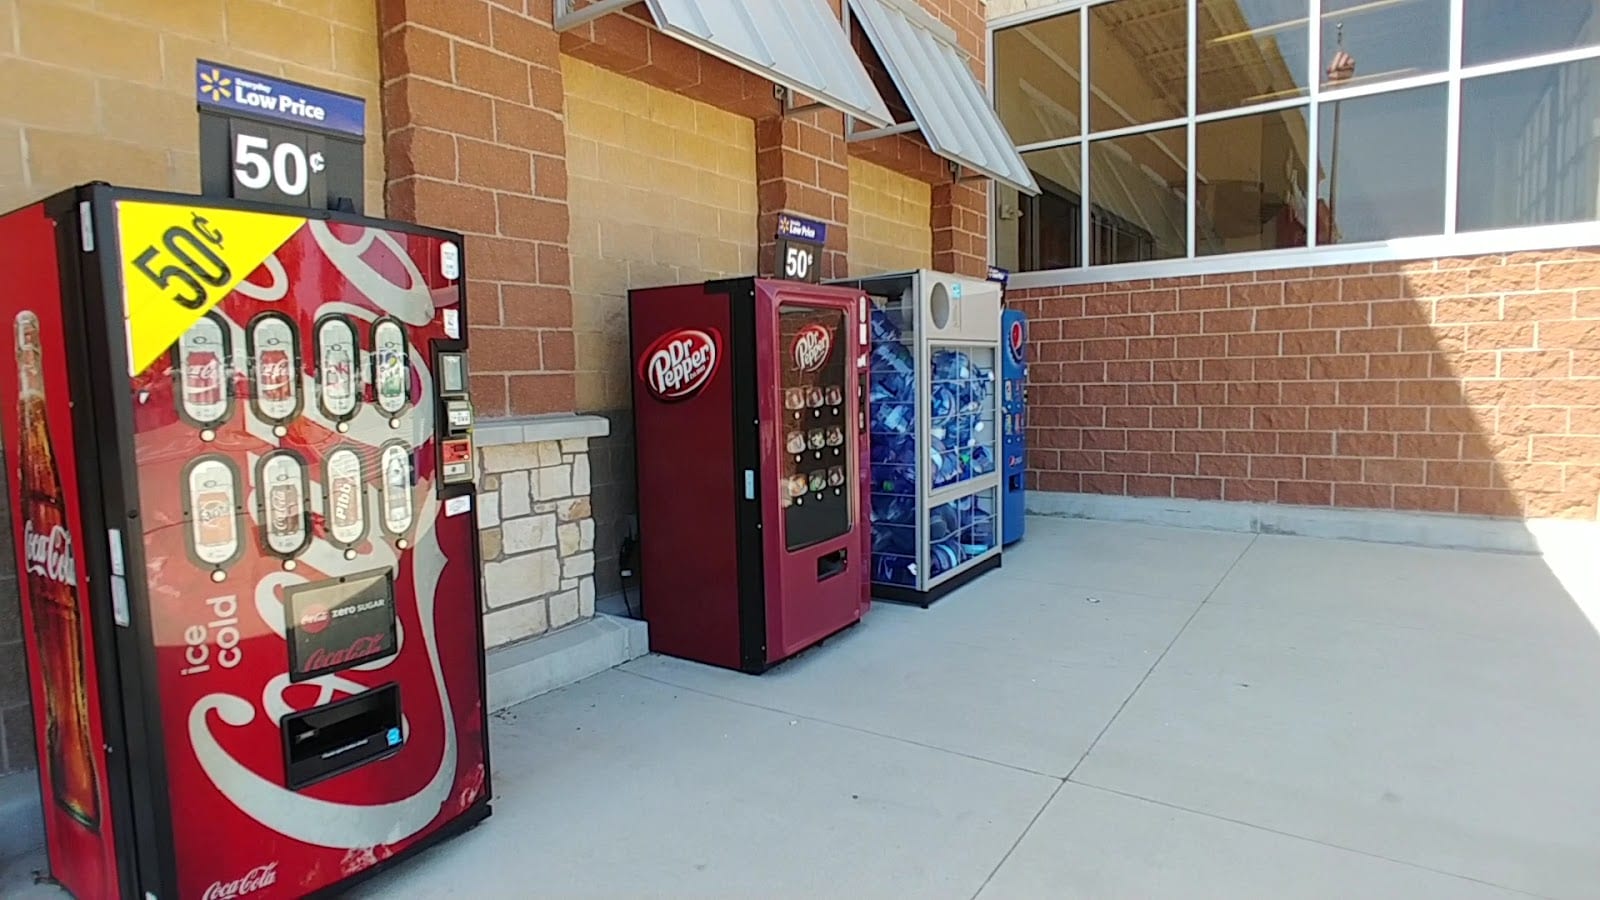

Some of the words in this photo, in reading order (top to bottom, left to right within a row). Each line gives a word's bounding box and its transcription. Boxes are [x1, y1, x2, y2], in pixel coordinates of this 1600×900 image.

[234, 84, 277, 110] Low
[279, 95, 325, 120] Price
[234, 134, 325, 195] 50¢
[131, 212, 231, 310] 50¢
[648, 344, 710, 394] Pepper
[668, 339, 693, 368] Dr
[206, 594, 242, 669] cold
[331, 606, 357, 618] zero
[357, 599, 385, 613] SUGAR
[180, 624, 210, 675] ice
[202, 860, 279, 900] Coca-Cola
